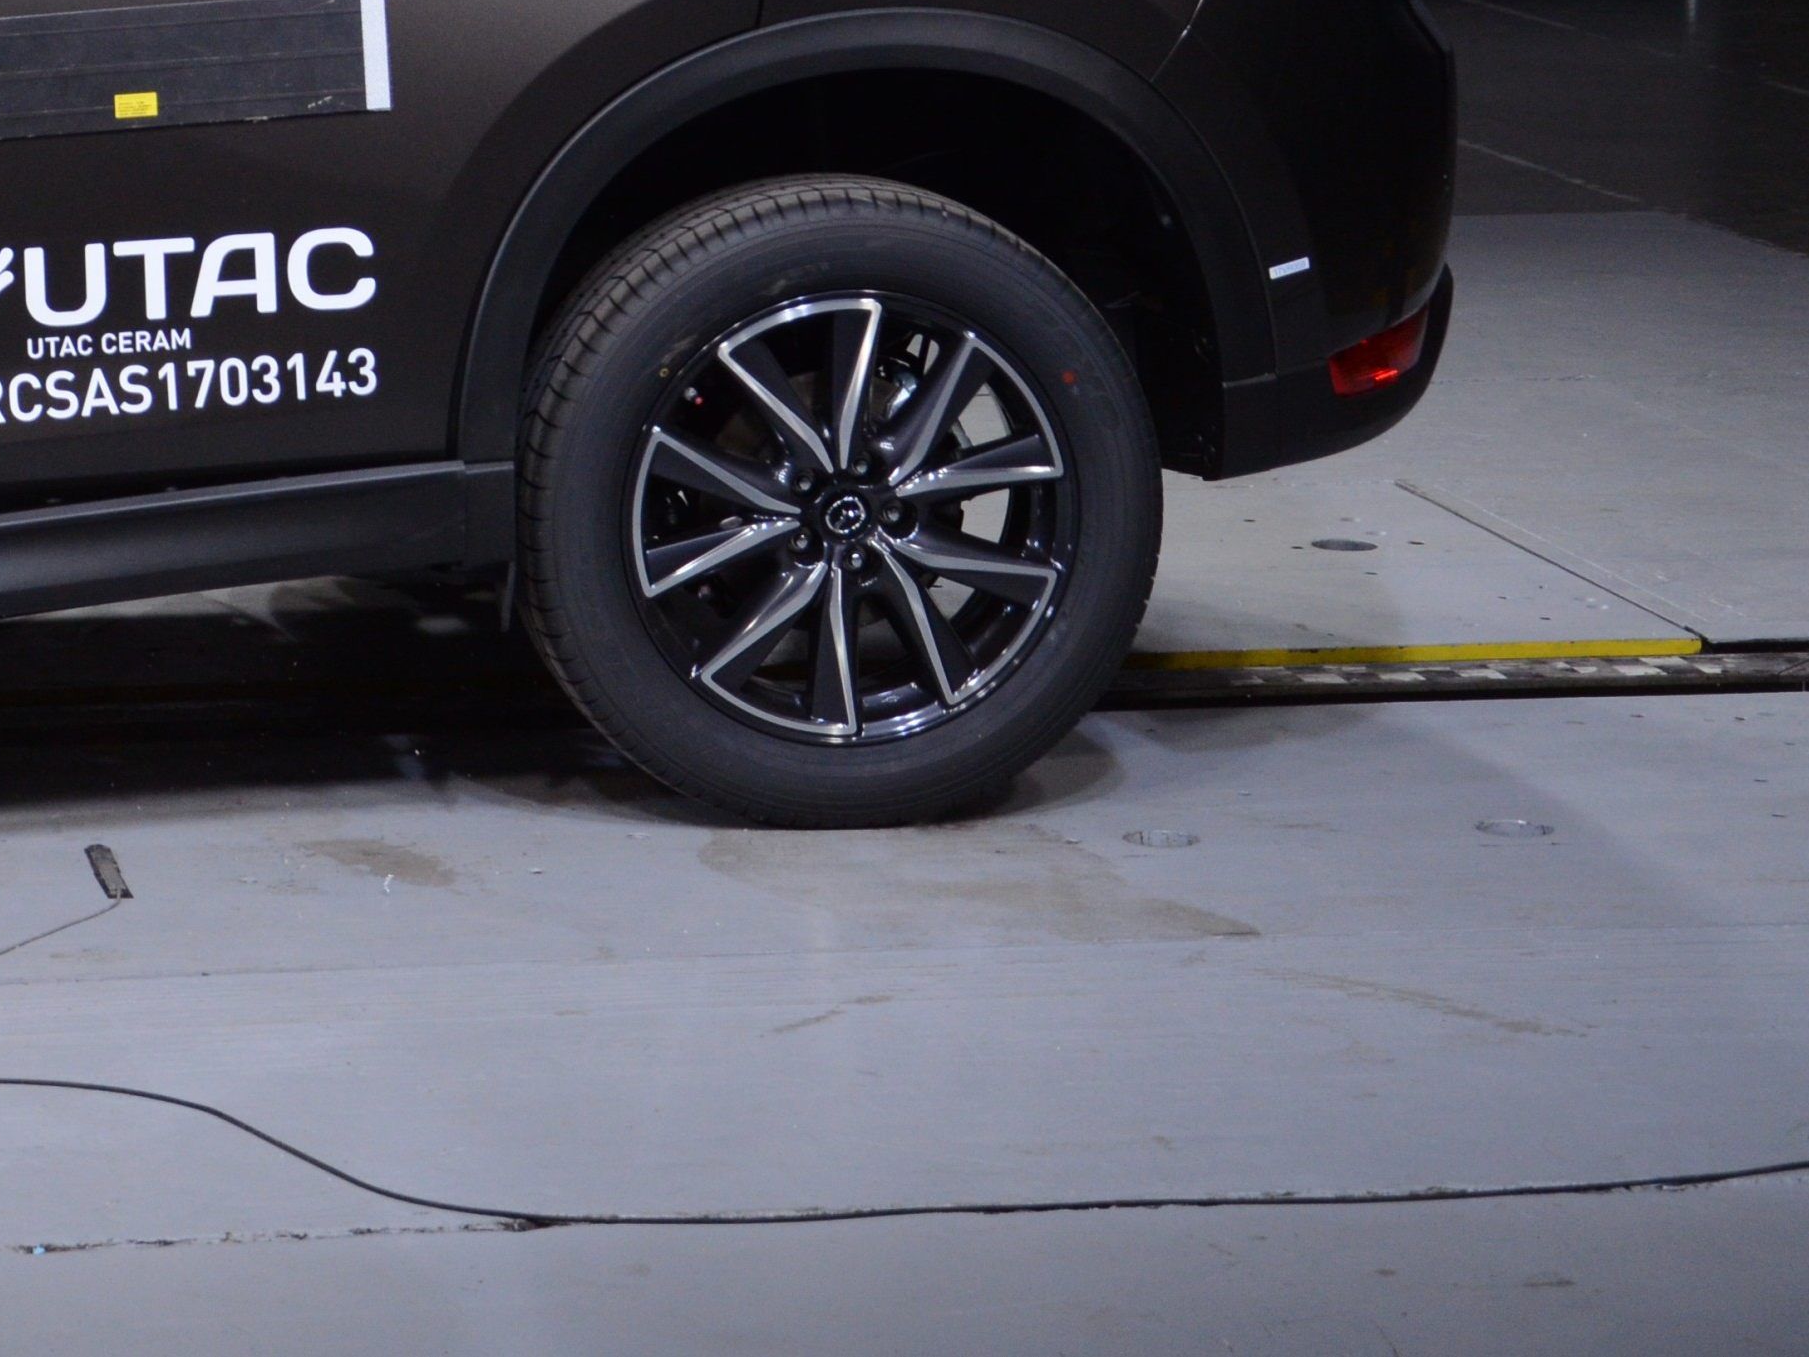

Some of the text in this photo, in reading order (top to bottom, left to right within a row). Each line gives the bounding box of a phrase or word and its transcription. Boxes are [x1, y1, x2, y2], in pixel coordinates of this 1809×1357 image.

[23, 227, 377, 327] UTAC
[26, 327, 192, 360] UTAC CERAM
